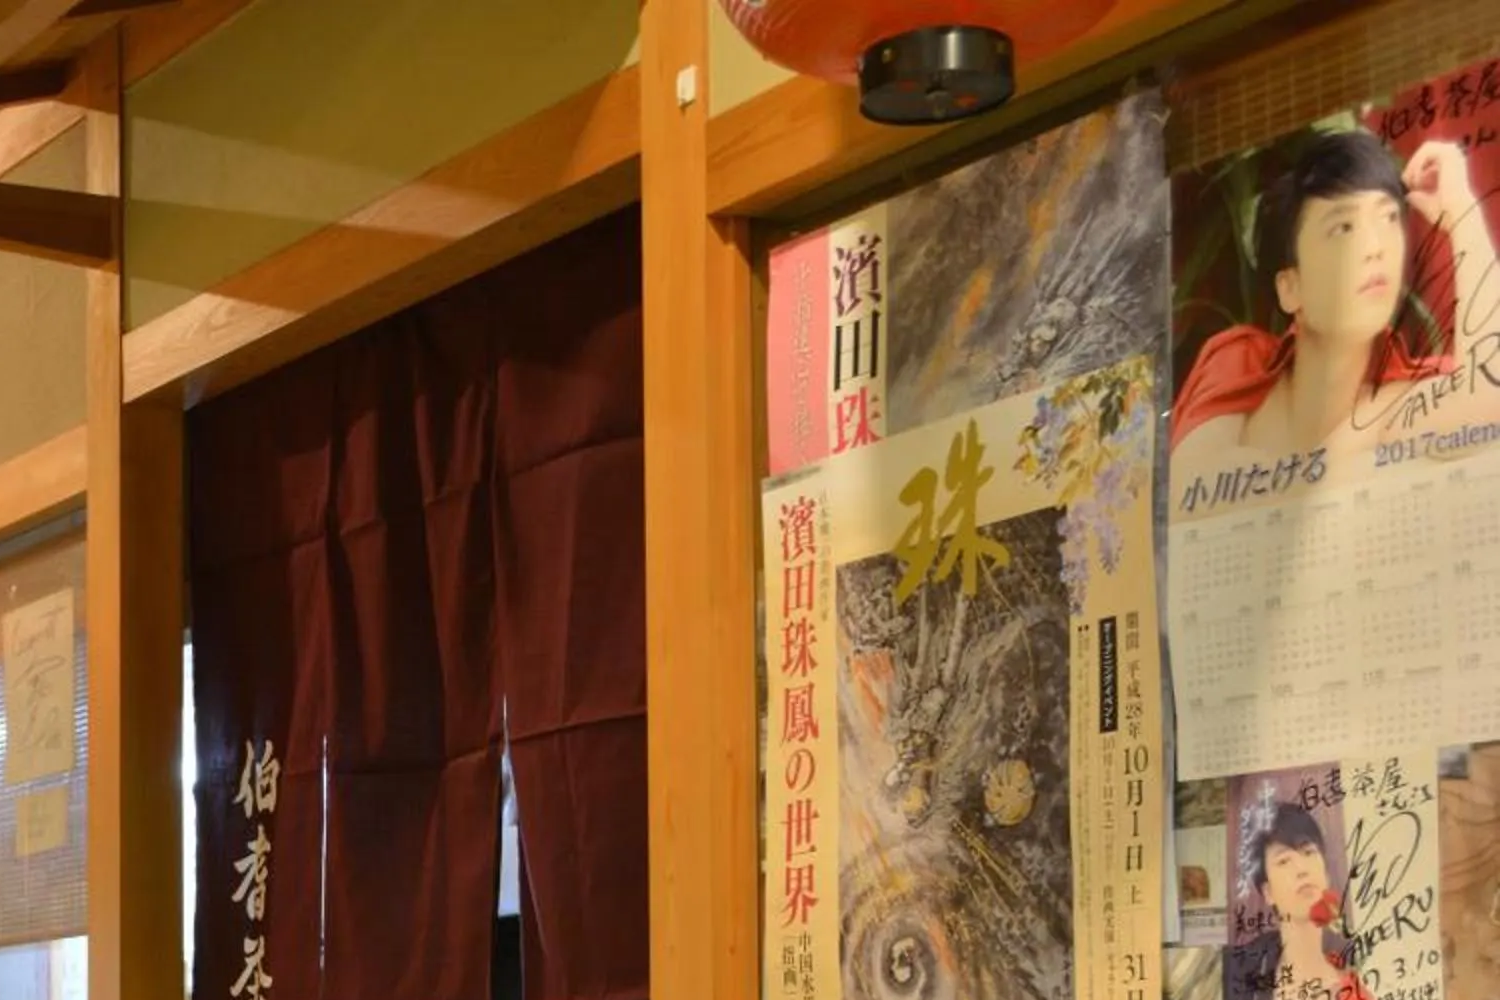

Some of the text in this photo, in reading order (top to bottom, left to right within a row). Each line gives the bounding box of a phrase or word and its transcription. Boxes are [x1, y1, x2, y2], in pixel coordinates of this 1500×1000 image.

[892, 417, 1011, 604] 珠
[1179, 447, 1326, 513] 小川たける
[778, 496, 819, 927] 濱田珠鳳の世界
